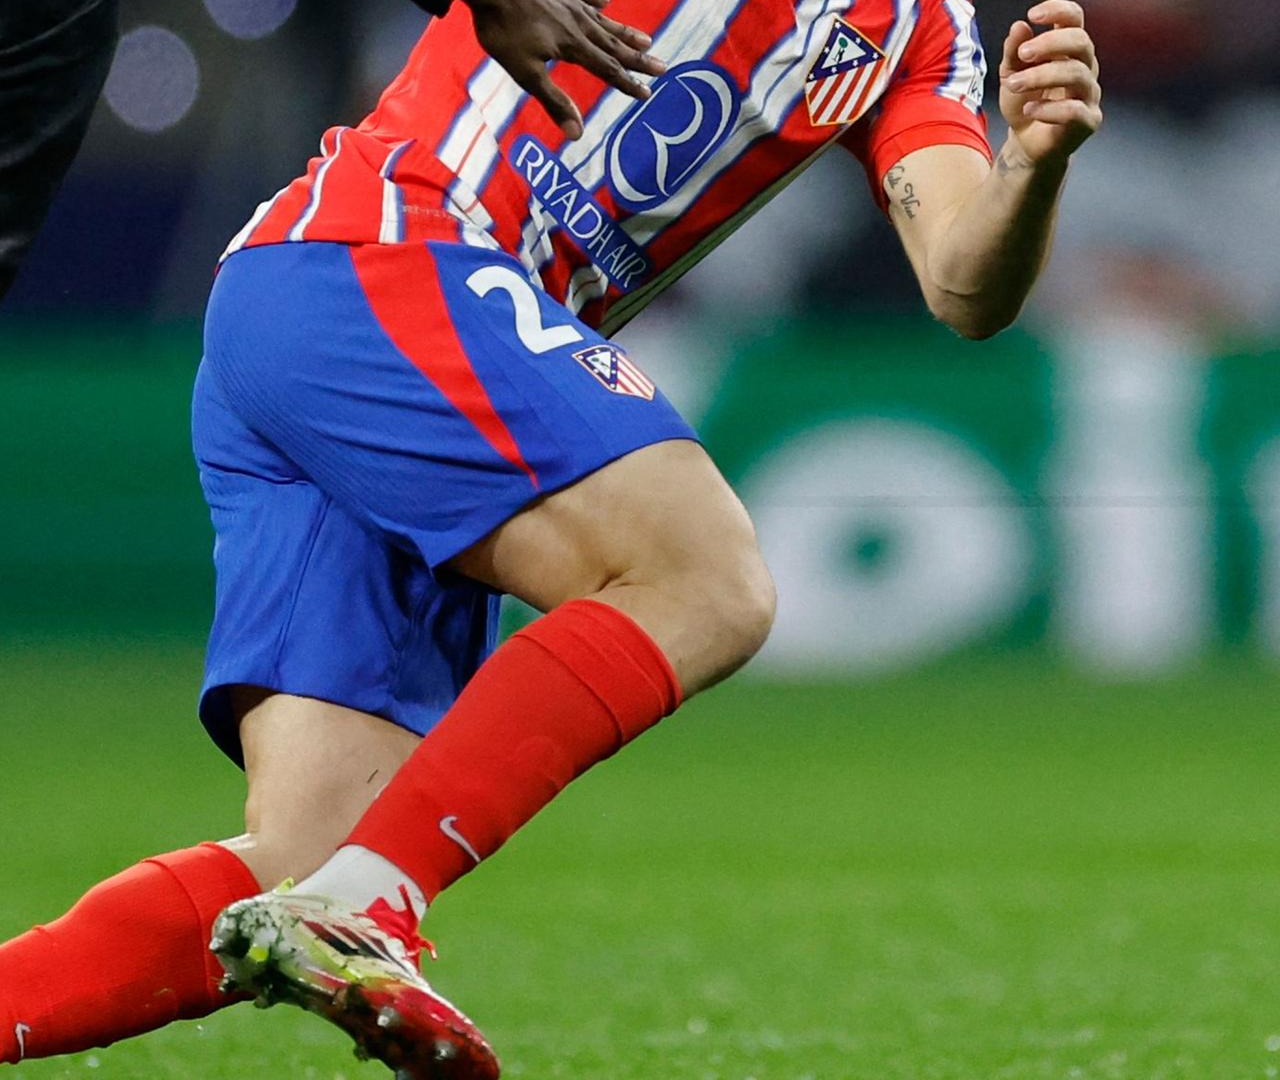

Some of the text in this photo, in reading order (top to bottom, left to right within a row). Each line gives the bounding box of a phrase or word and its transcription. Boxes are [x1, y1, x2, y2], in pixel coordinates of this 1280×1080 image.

[515, 140, 648, 289] RIYADH AIR
[465, 265, 585, 355] 2
